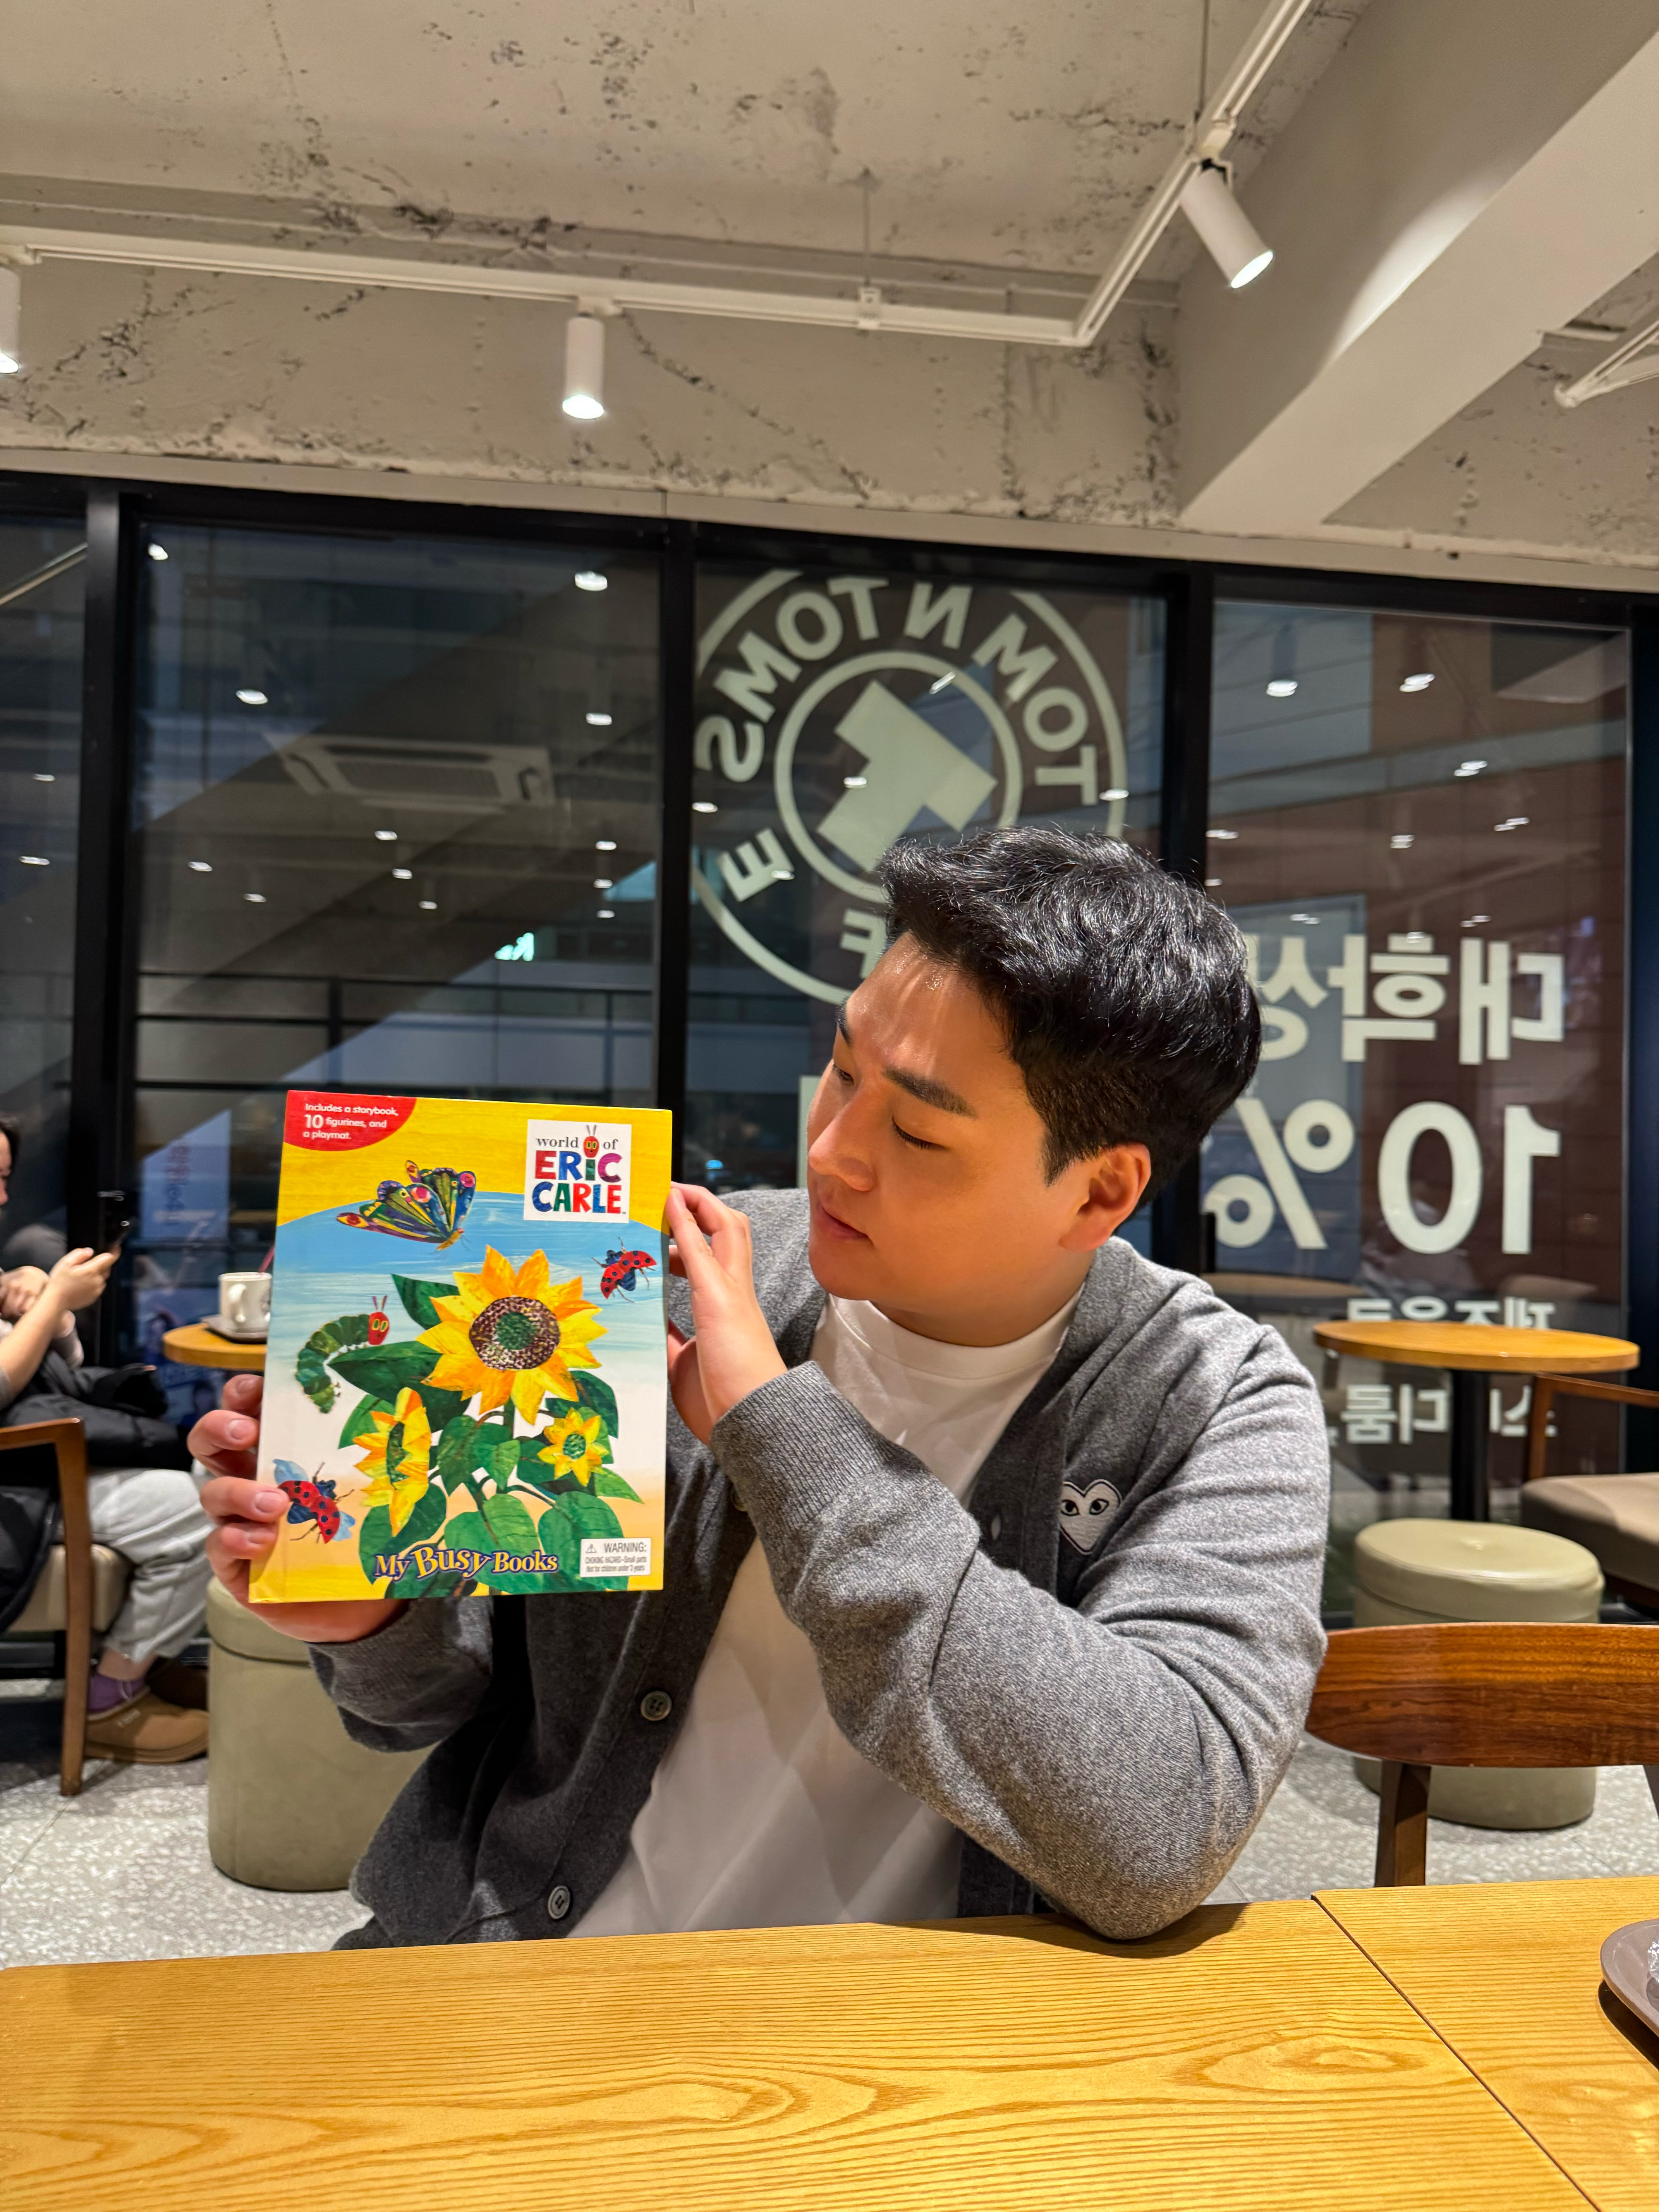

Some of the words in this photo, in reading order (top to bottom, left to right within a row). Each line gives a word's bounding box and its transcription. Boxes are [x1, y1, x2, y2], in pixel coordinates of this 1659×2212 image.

[304, 1103, 342, 1112] Includes
[353, 1106, 399, 1116] storybook,
[304, 1114, 324, 1128] 10
[326, 1117, 367, 1128] figurines,
[312, 1130, 352, 1140] playmat.
[536, 1137, 579, 1148] world
[603, 1139, 619, 1150] of
[532, 1181, 622, 1214] CARLE
[604, 1542, 647, 1553] WARNING:
[374, 1554, 411, 1581] My
[410, 1546, 491, 1578] Busy
[492, 1550, 558, 1572] Books
